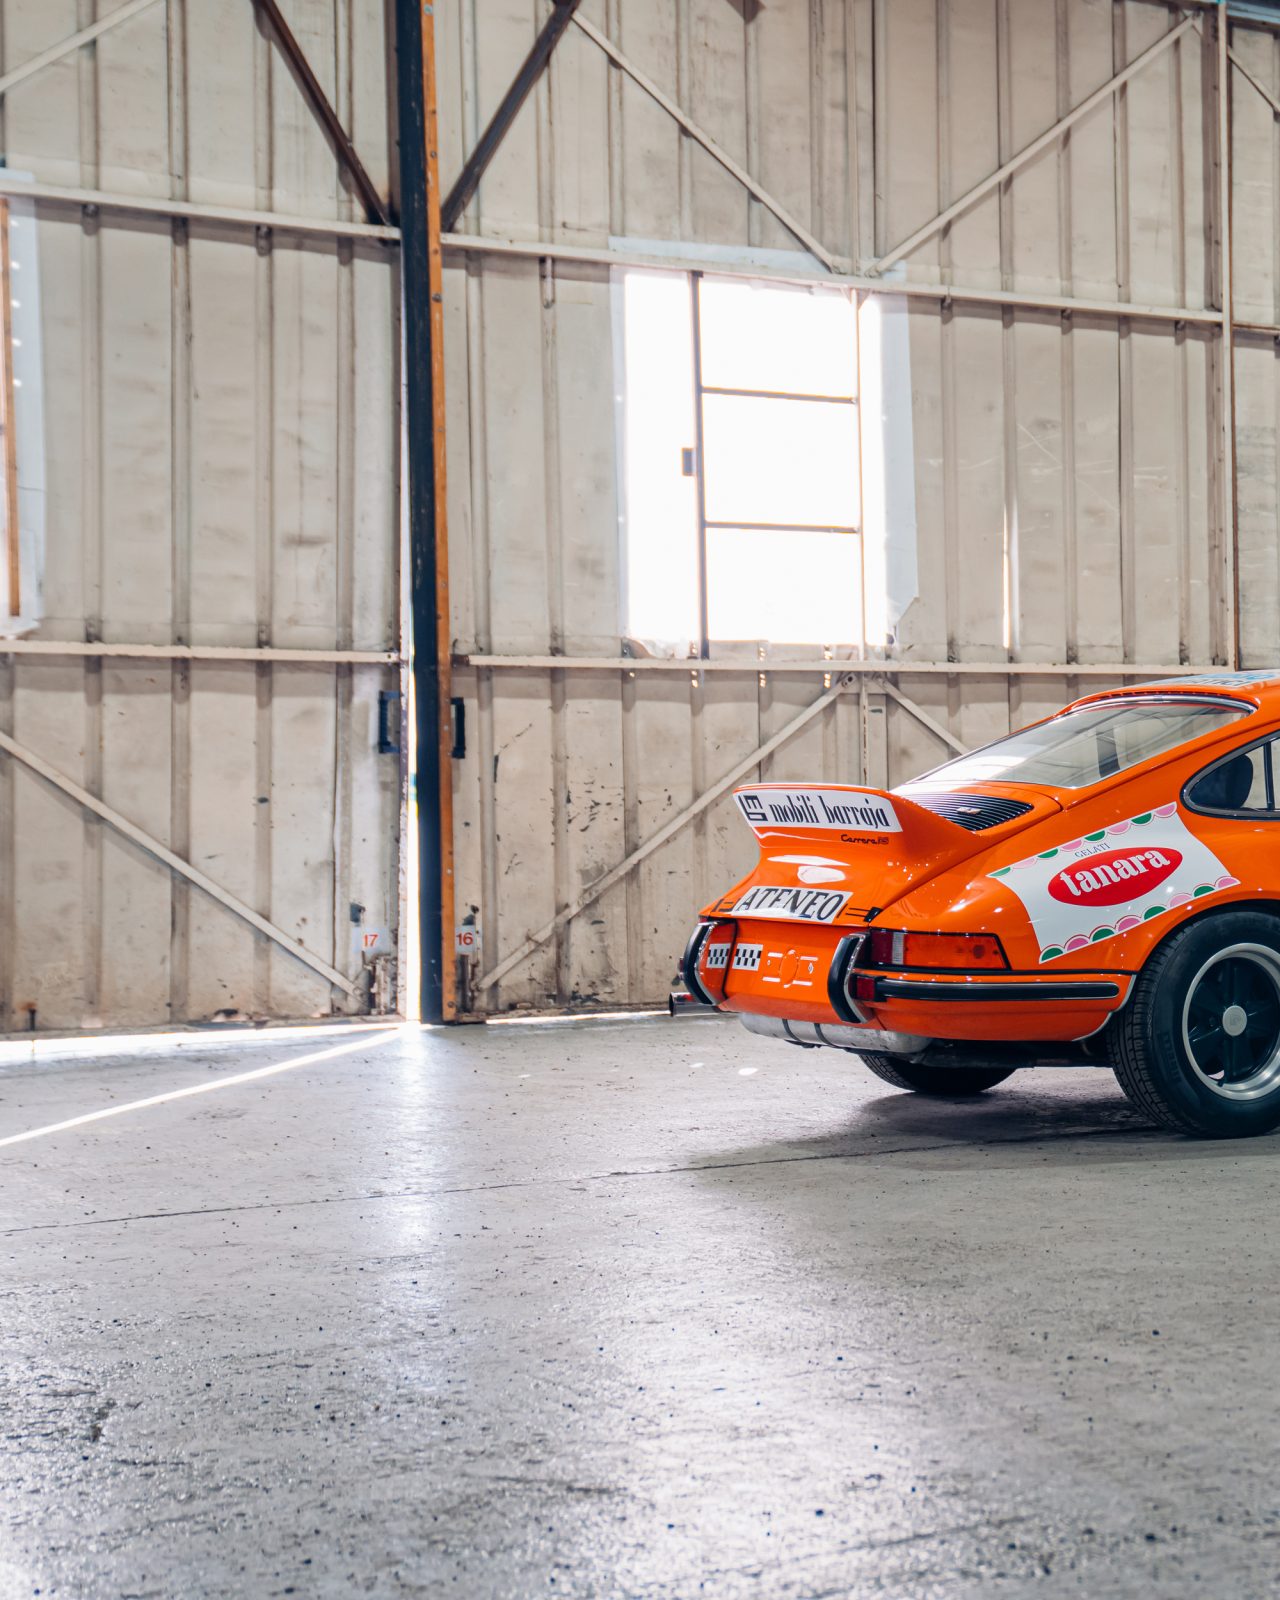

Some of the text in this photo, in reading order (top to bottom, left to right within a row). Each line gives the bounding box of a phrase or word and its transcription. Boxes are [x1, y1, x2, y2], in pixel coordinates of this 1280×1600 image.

[769, 794, 891, 829] mobili barraja
[841, 834, 877, 845] Carrera
[1074, 842, 1111, 858] GELATI
[1059, 850, 1171, 897] tanara
[735, 887, 844, 921] ATENEO
[362, 933, 379, 948] 17
[455, 932, 474, 946] 16
